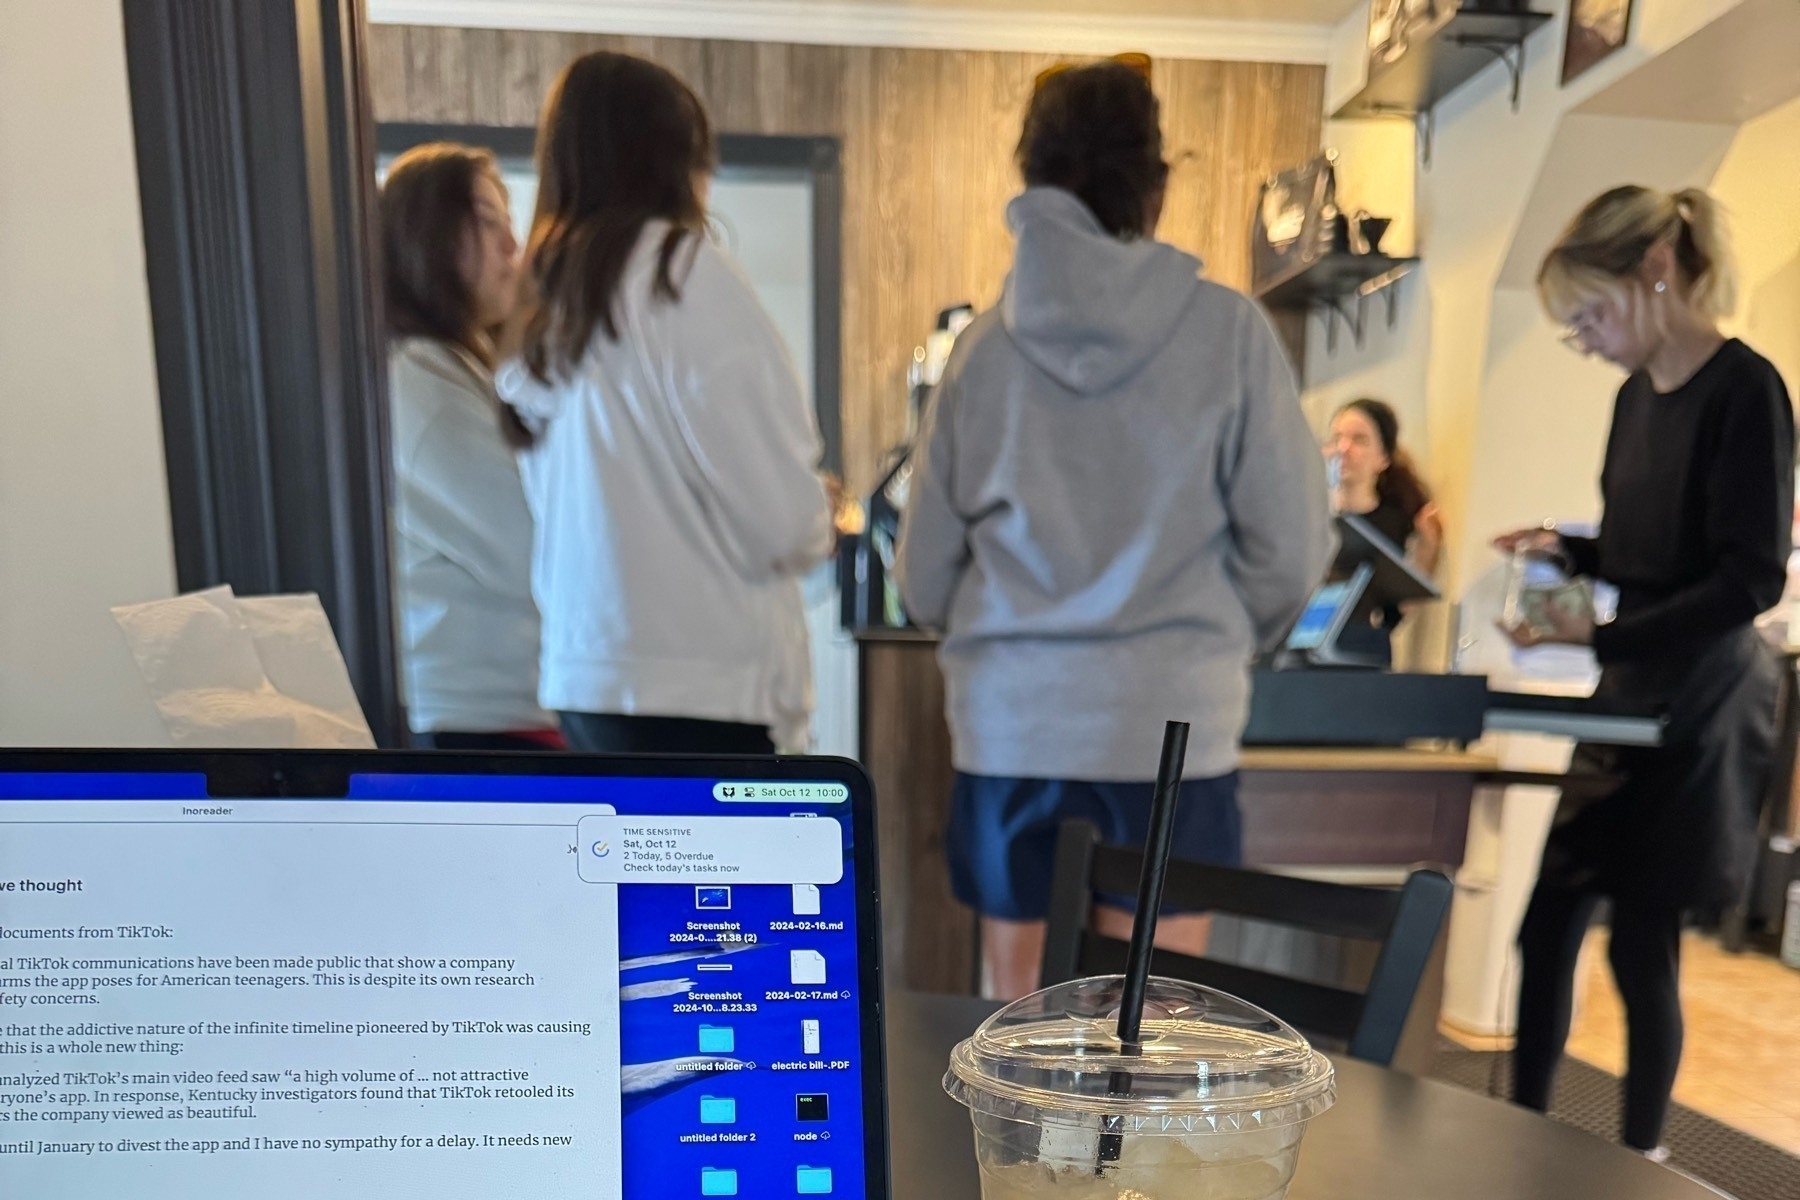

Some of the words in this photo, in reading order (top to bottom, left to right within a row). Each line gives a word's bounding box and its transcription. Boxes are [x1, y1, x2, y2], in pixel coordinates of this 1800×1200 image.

[762, 788, 776, 796] Sat
[780, 788, 795, 796] Oct
[817, 789, 843, 797] 10:00
[183, 807, 233, 815] Inoreader
[647, 828, 690, 836] SENSITIVE
[624, 839, 642, 850] Sat,
[646, 839, 662, 848] Oct
[666, 840, 676, 848] 12
[624, 851, 629, 860] 2
[632, 851, 662, 862] Today,
[666, 852, 671, 860] 5
[674, 852, 713, 860] Overdue
[624, 863, 653, 872] Check
[693, 864, 718, 872] tasks
[20, 879, 82, 894] thought
[687, 921, 740, 930] Screenshot
[770, 921, 843, 930] 2024-02-16.md
[78, 925, 113, 938] from
[117, 925, 173, 938] TikTok:
[0, 957, 13, 970] al
[17, 957, 69, 970] TikTok
[72, 956, 194, 969] communications
[198, 956, 232, 968] have
[235, 956, 269, 968] been
[274, 956, 313, 968] made
[316, 956, 361, 971] public
[364, 956, 394, 968] that
[398, 956, 436, 968] show
[438, 959, 446, 969] a
[450, 959, 515, 972] company
[35, 974, 58, 987] the
[62, 977, 88, 990] app
[92, 977, 132, 990] poses
[136, 973, 158, 986] for
[160, 973, 231, 986] American
[235, 975, 309, 989] teenagers.
[312, 973, 345, 985] This
[348, 973, 360, 985] is
[364, 973, 416, 989] despite
[420, 973, 437, 986] its
[441, 976, 471, 986] own
[475, 973, 534, 986] research
[30, 995, 100, 1005] concerns.
[688, 991, 742, 1000] Screenshot
[766, 991, 838, 1000] 2024-02-17.md
[6, 1023, 36, 1036] that
[40, 1023, 63, 1036] the
[67, 1023, 133, 1036] addictive
[137, 1024, 185, 1035] nature
[188, 1021, 204, 1034] of
[207, 1022, 231, 1034] the
[234, 1021, 288, 1034] infinite
[292, 1021, 353, 1034] timeline
[356, 1021, 428, 1037] pioneered
[432, 1020, 449, 1037] by
[452, 1020, 503, 1033] TikTok
[506, 1023, 533, 1033] was
[537, 1020, 591, 1036] causing
[0, 1041, 26, 1054] this
[31, 1041, 42, 1054] is
[46, 1044, 54, 1054] a
[58, 1040, 102, 1053] whole
[106, 1043, 136, 1053] new
[140, 1040, 183, 1056] thing:
[675, 1061, 713, 1071] untitled
[715, 1061, 743, 1071] folder
[63, 1071, 129, 1085] TikTok’s
[132, 1072, 170, 1084] main
[173, 1071, 213, 1083] video
[217, 1070, 248, 1083] feed
[252, 1073, 280, 1083] saw
[285, 1069, 301, 1082] “a
[305, 1069, 338, 1086] high
[341, 1069, 396, 1082] volume
[400, 1069, 414, 1082] of
[433, 1070, 457, 1081] not
[460, 1068, 528, 1081] attractive
[60, 1093, 90, 1106] app.
[94, 1090, 109, 1102] In
[113, 1092, 184, 1105] response,
[188, 1087, 258, 1104] Kentucky
[261, 1087, 357, 1103] investigators
[360, 1086, 403, 1099] found
[407, 1086, 436, 1099] that
[440, 1085, 491, 1099] TikTok
[495, 1085, 553, 1098] retooled
[557, 1085, 574, 1097] its
[14, 1108, 38, 1121] the
[41, 1111, 109, 1124] company
[112, 1106, 163, 1120] viewed
[168, 1109, 183, 1119] as
[186, 1105, 256, 1119] beautiful.
[680, 1133, 717, 1142] untitled
[719, 1133, 748, 1142] folder
[750, 1133, 756, 1141] 2
[794, 1132, 817, 1141] node
